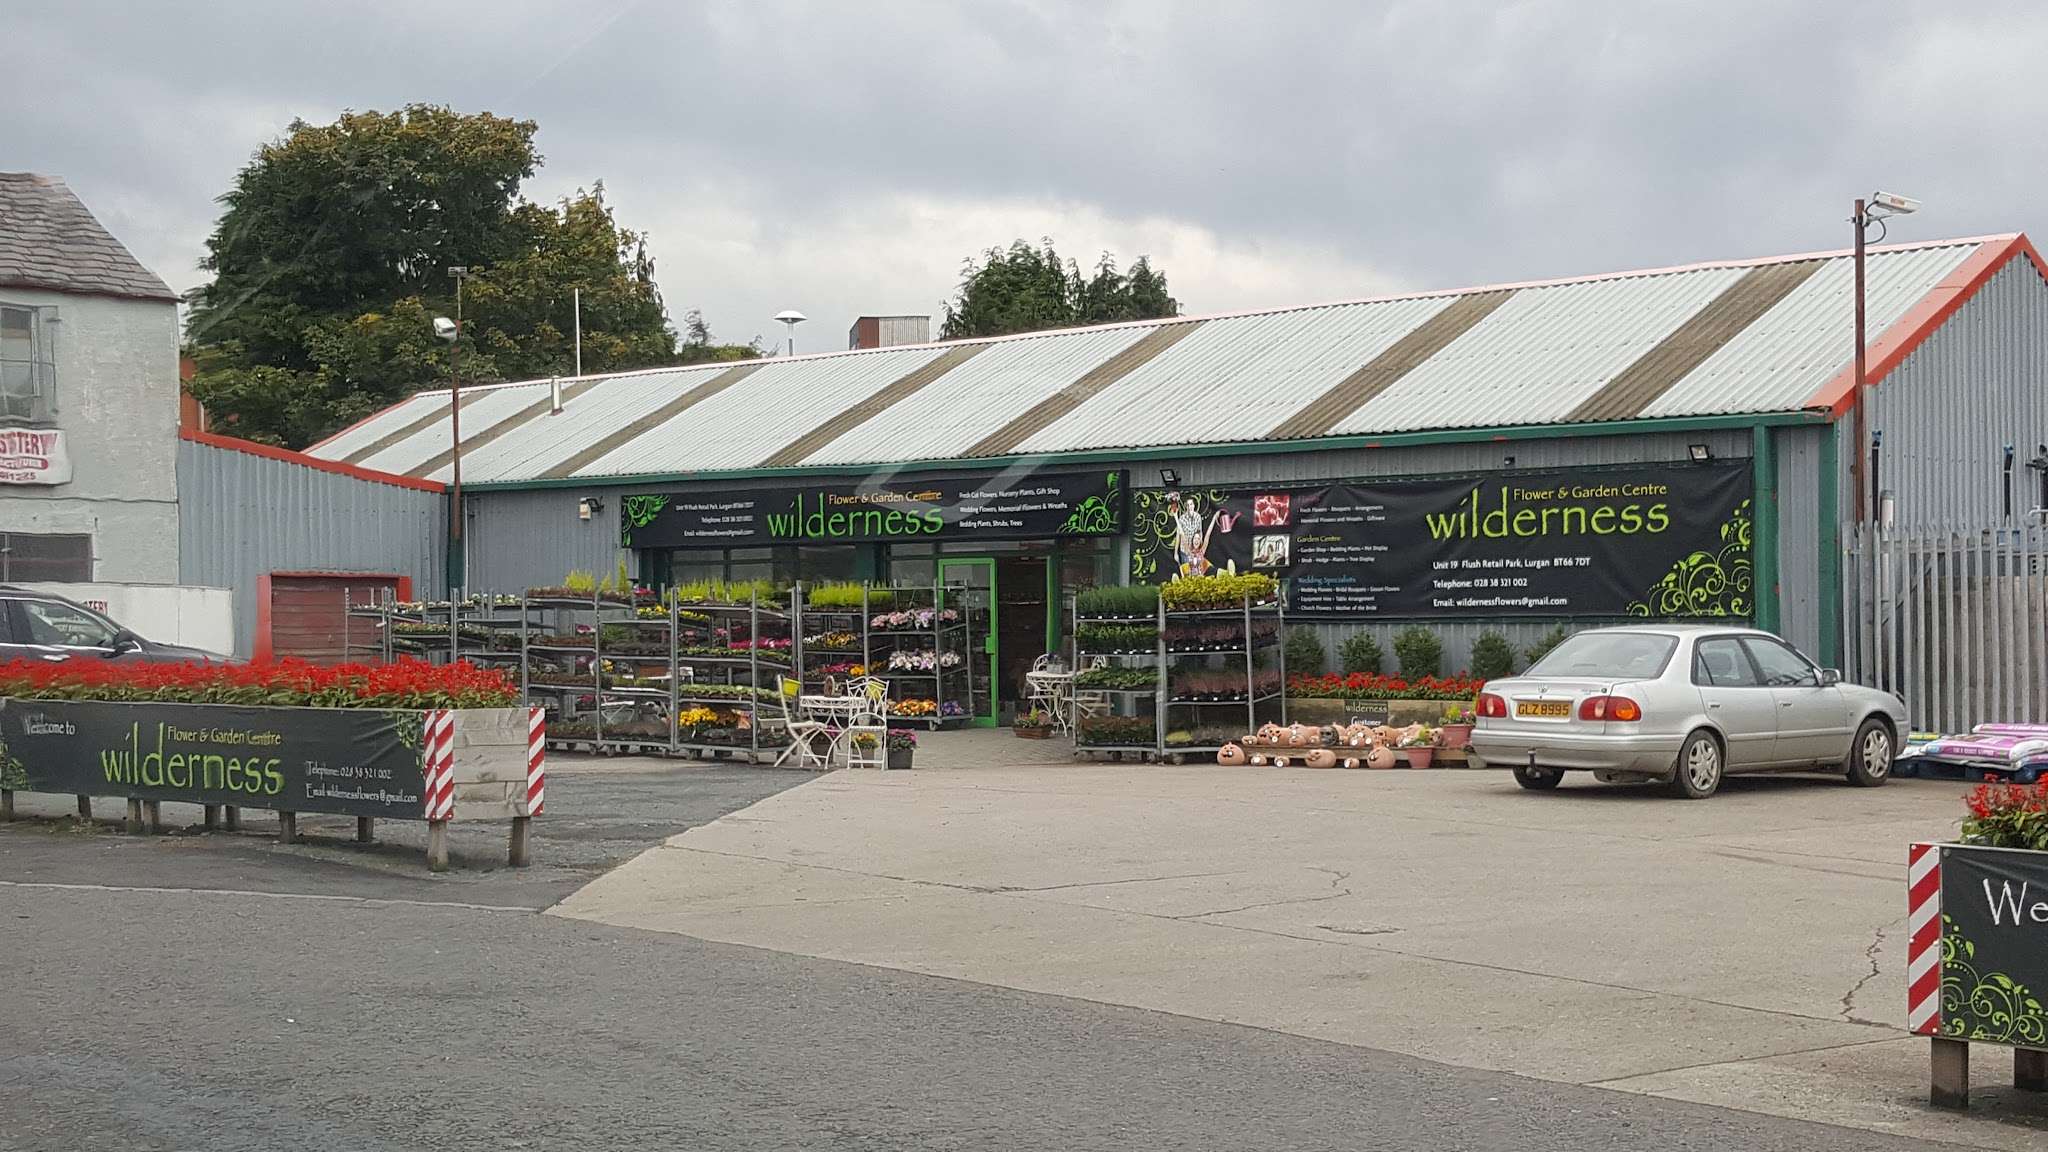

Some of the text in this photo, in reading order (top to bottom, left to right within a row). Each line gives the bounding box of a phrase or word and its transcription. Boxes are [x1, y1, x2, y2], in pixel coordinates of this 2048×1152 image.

[828, 494, 859, 505] Flower
[861, 493, 868, 503] &
[871, 492, 904, 503] Garden
[1047, 487, 1060, 496] Shop
[1513, 483, 1667, 501] Flower & Garden Centre
[767, 492, 944, 538] wilderness
[1425, 485, 1670, 540] wilderness
[1433, 557, 1591, 569] Unit 19 Flush Retail Park, Lurgan BT66 7DT
[1433, 578, 1528, 590] Telephone: 028 38 321 002
[1433, 597, 1568, 608] Email: wildernessflowers@gmail.com
[1345, 701, 1387, 712] wilderness
[1518, 703, 1538, 715] GLZ
[66, 720, 75, 735] to
[168, 726, 198, 742] Flower
[200, 727, 208, 743] &
[211, 727, 244, 745] Garden
[102, 721, 285, 795] wilderness
[1983, 878, 2048, 926] We
